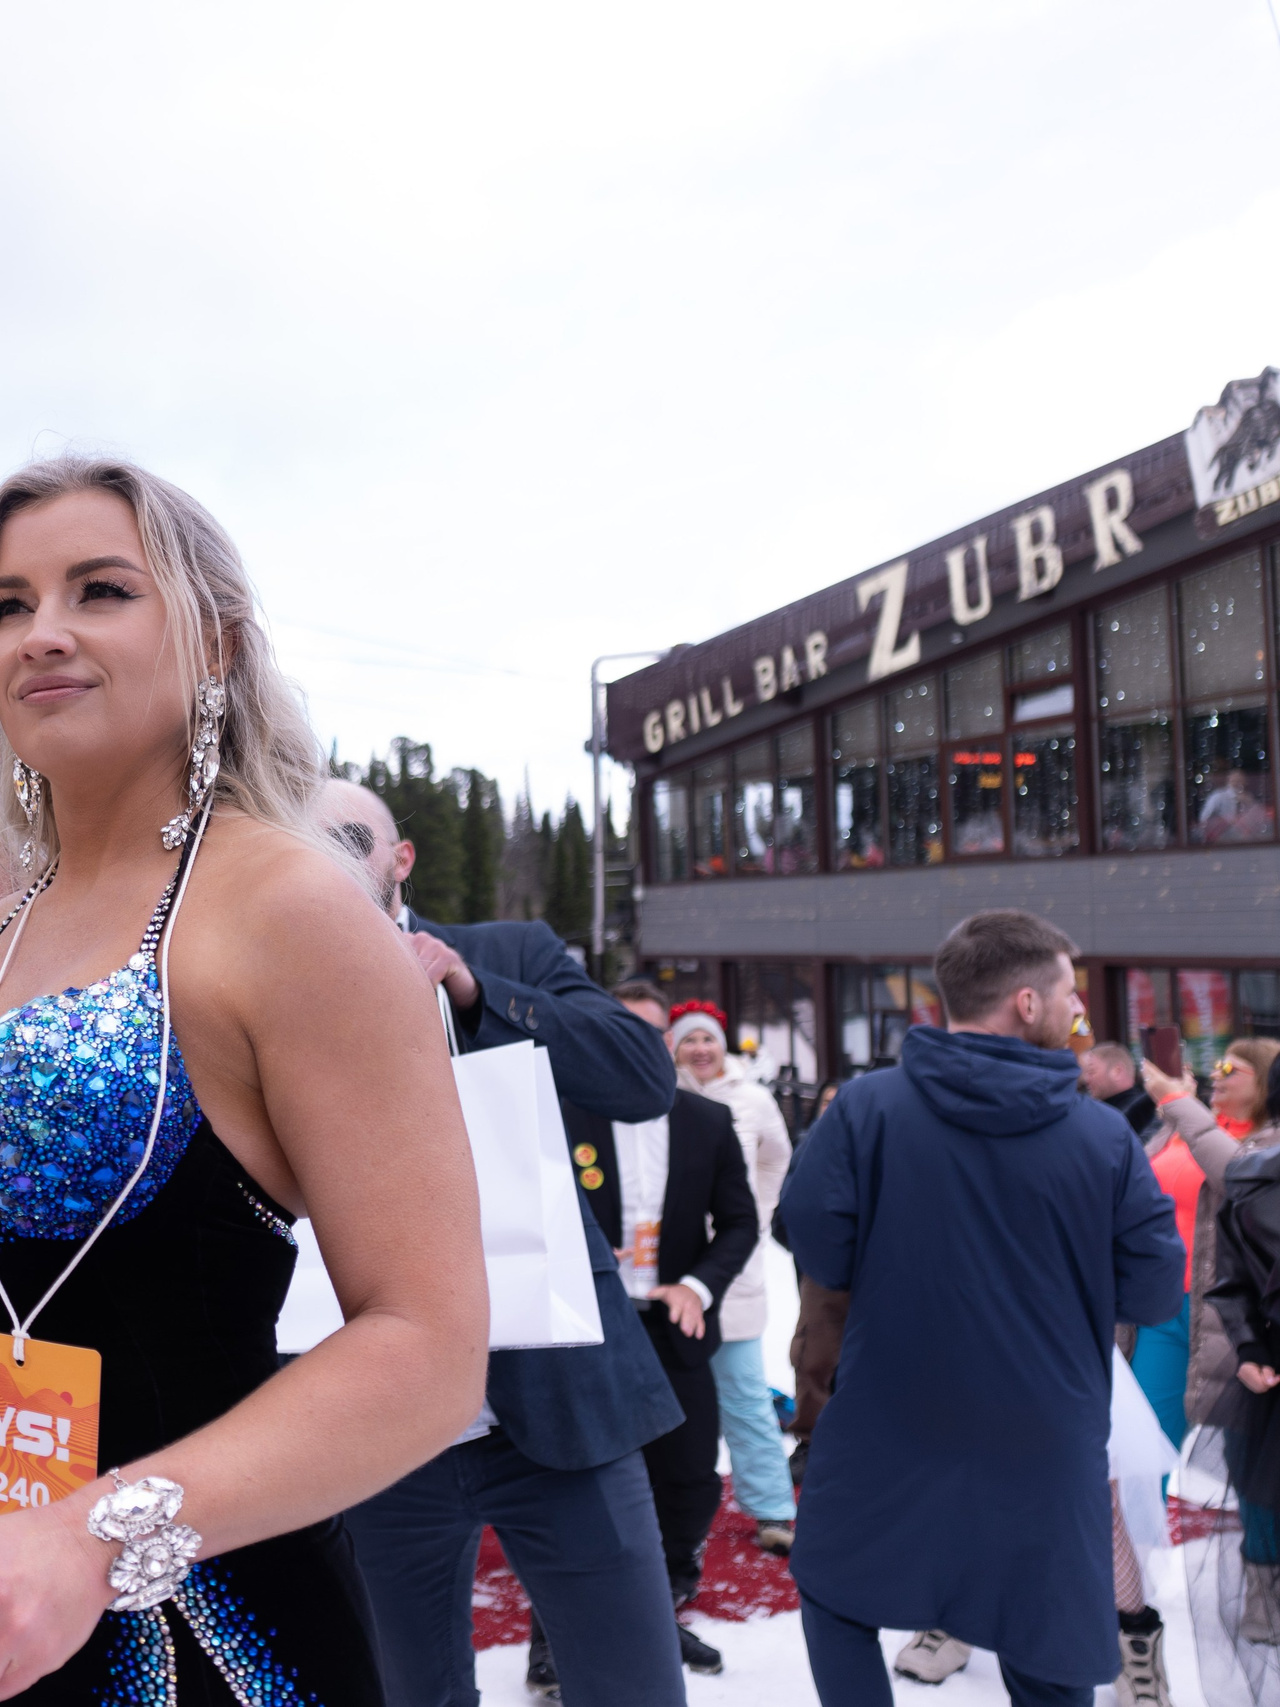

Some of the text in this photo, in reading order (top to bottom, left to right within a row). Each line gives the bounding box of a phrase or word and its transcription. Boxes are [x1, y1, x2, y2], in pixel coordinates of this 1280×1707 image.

[643, 467, 1143, 753] GRILL BAR ZUBR
